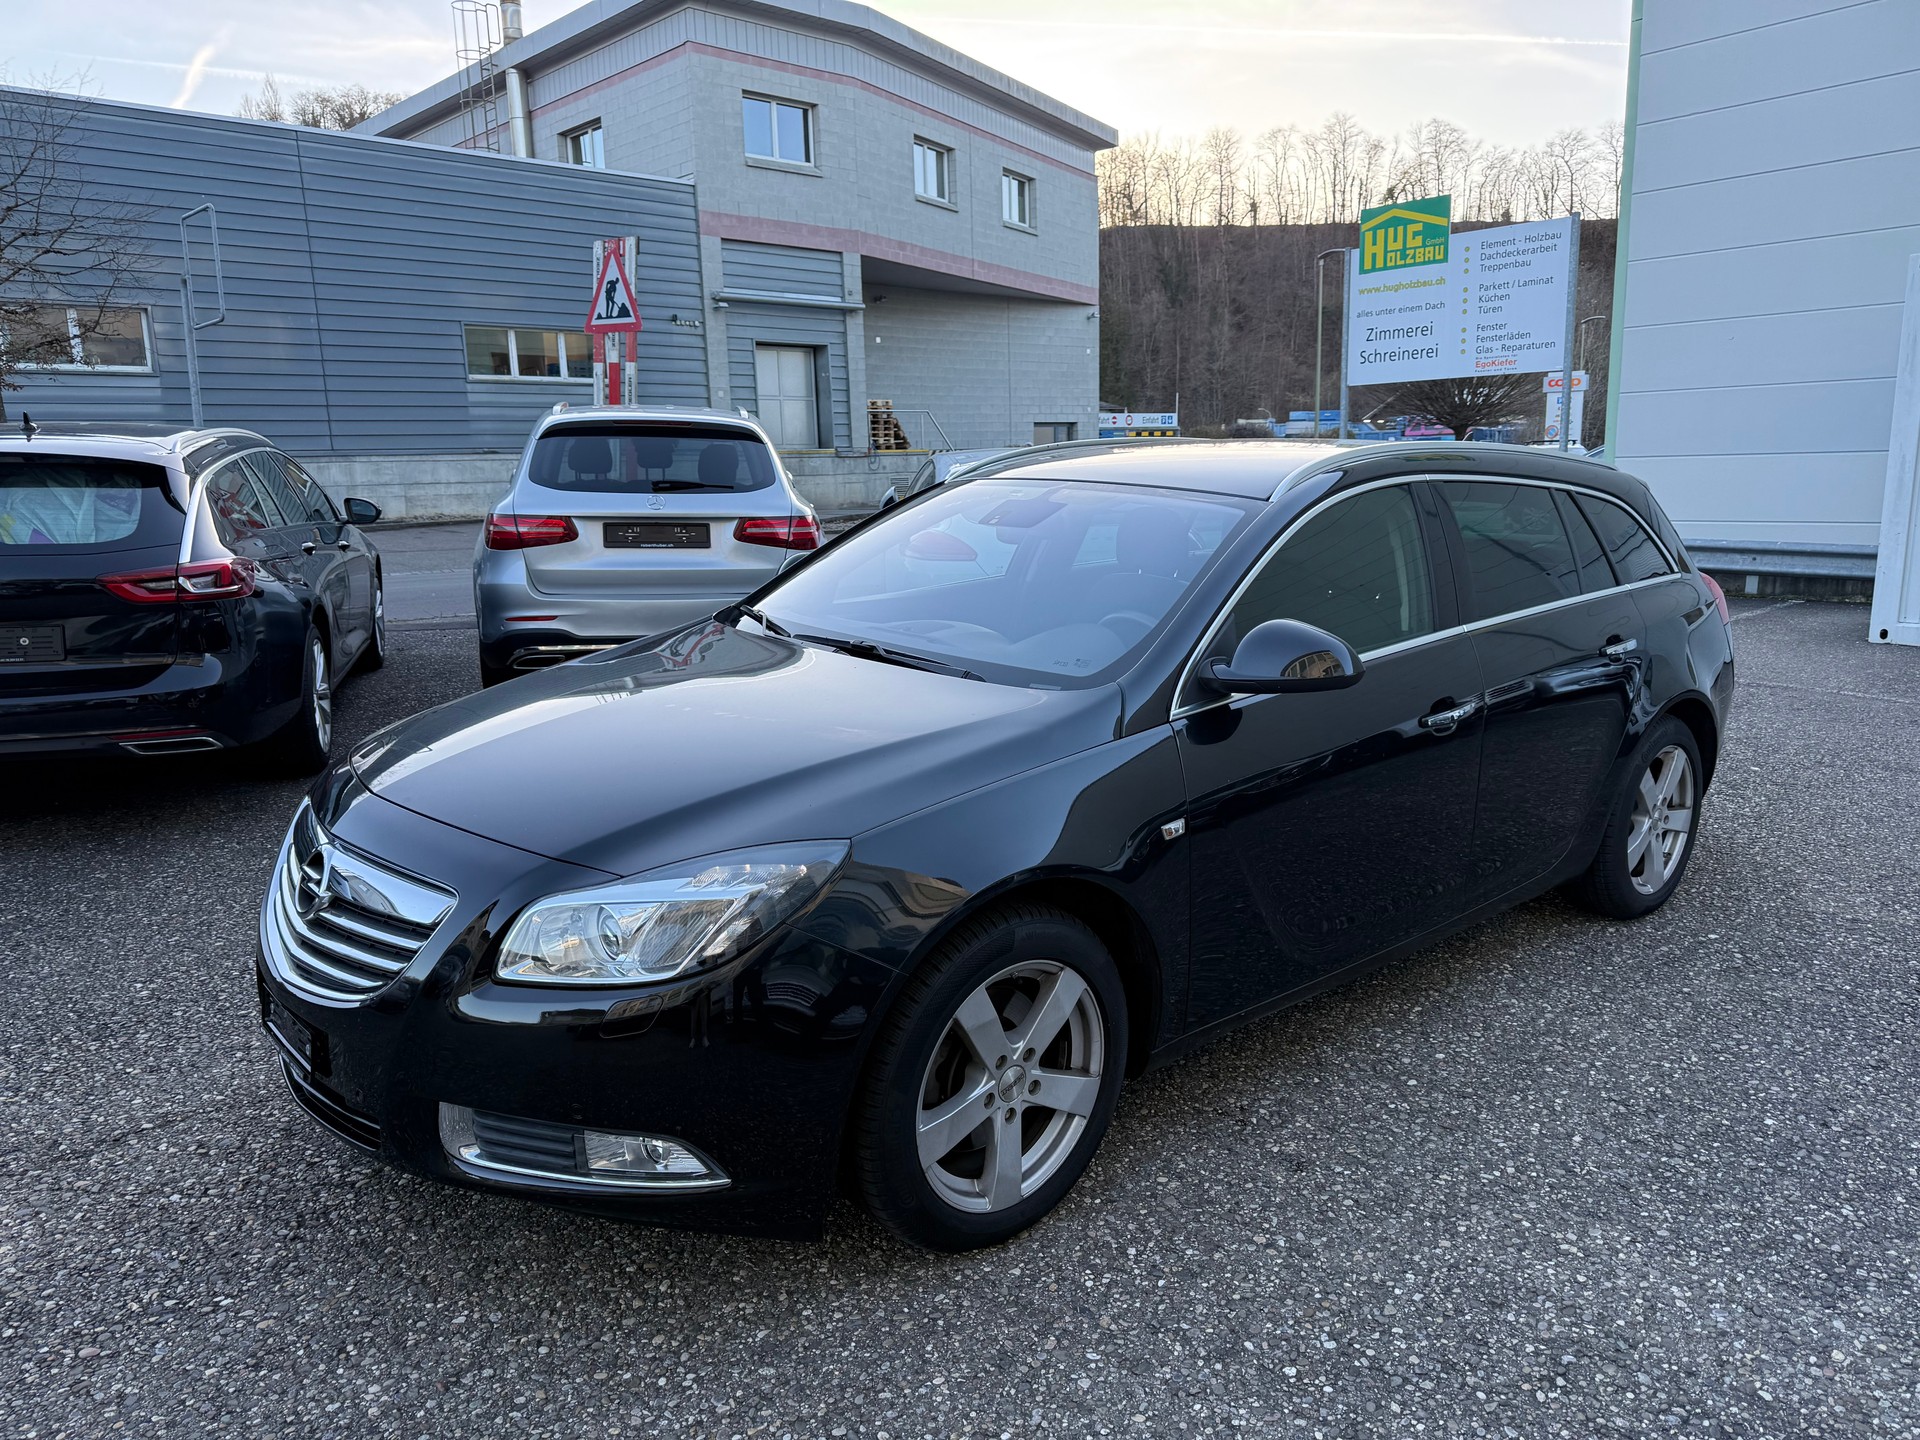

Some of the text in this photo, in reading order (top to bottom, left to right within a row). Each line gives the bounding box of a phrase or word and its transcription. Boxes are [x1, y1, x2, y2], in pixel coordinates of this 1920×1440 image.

[1364, 222, 1423, 270] HUG
[1425, 236, 1445, 246] GmbH
[1480, 237, 1516, 250] Element
[1524, 231, 1562, 244] Holzbau
[1480, 243, 1558, 261] Dachdeckerarbeit
[1480, 259, 1532, 273] Treppenbau
[1358, 276, 1446, 296] www.hugholzbau.ch
[1479, 276, 1554, 292] Parkett / Laminat
[1478, 292, 1511, 303] Küchen
[1356, 300, 1446, 319] alles unter einem Dach
[1478, 304, 1503, 315] Türen
[1366, 320, 1434, 342] Zimmerei
[1476, 322, 1508, 332] Fenster
[1476, 331, 1531, 343] Fensterläden
[1359, 343, 1439, 365] Schreinerei
[1475, 345, 1494, 355] Glas
[1501, 341, 1556, 353] Reparaturen
[1475, 358, 1518, 369] EgoKiefer
[1548, 377, 1582, 389] cop
